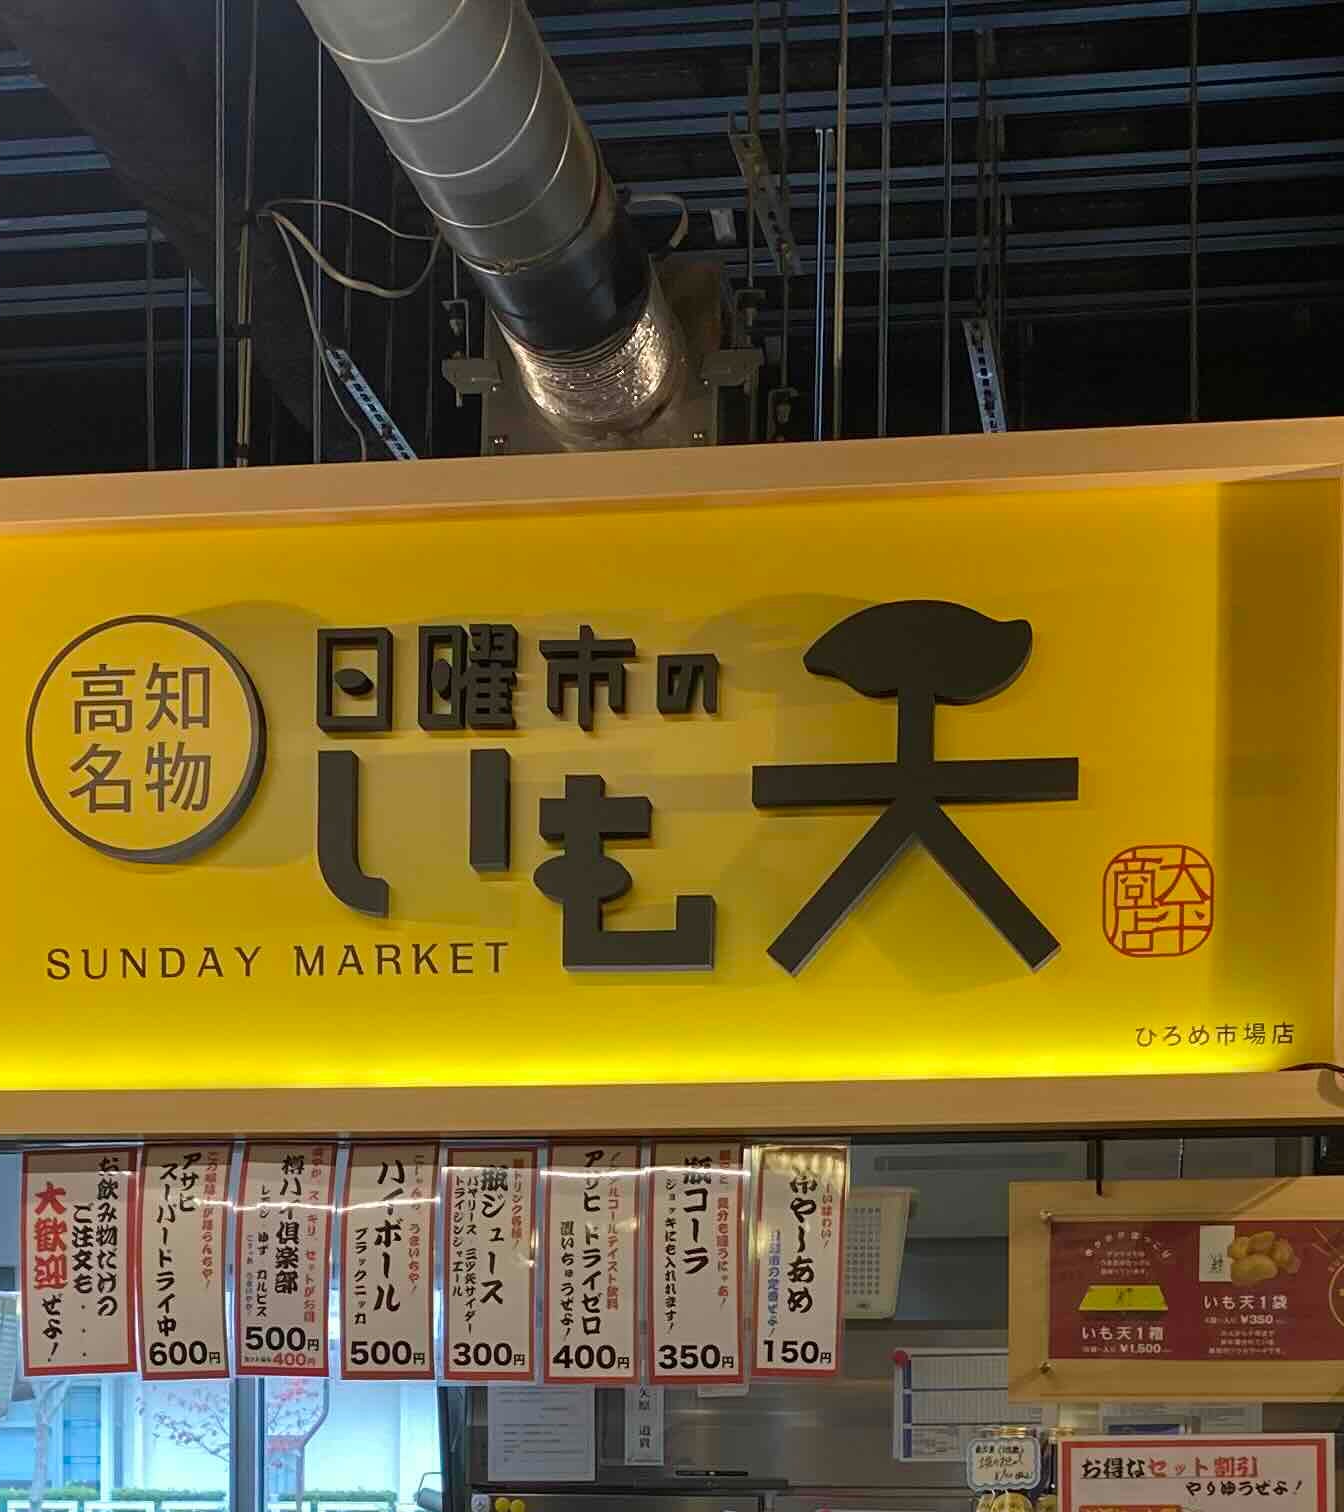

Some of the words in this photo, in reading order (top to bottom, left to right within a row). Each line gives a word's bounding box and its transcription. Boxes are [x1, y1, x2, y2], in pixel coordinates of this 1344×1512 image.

[70, 660, 212, 735] 高知
[316, 622, 720, 734] 日曜市の
[70, 742, 212, 812] 名物
[46, 943, 263, 981] SUNDAY
[293, 939, 510, 977] MARKET
[1135, 1022, 1297, 1048] ひろめ市場店
[179, 1151, 202, 1213] アサヒ
[96, 1155, 119, 1318] お飲み物だけの
[373, 1159, 406, 1312] ハイボール
[479, 1163, 509, 1306] 瓶ジュース
[682, 1156, 713, 1275] 瓶コーラ
[154, 1163, 179, 1337] スーパードライ中
[148, 1340, 221, 1367] 600円
[244, 1325, 320, 1353] 500円
[349, 1340, 426, 1367] 500円
[452, 1341, 525, 1367] 300円
[552, 1344, 630, 1370] 400円
[657, 1343, 734, 1370] 350円
[761, 1340, 832, 1366] 150円
[1080, 1456, 1260, 1480] お得なセット割引
